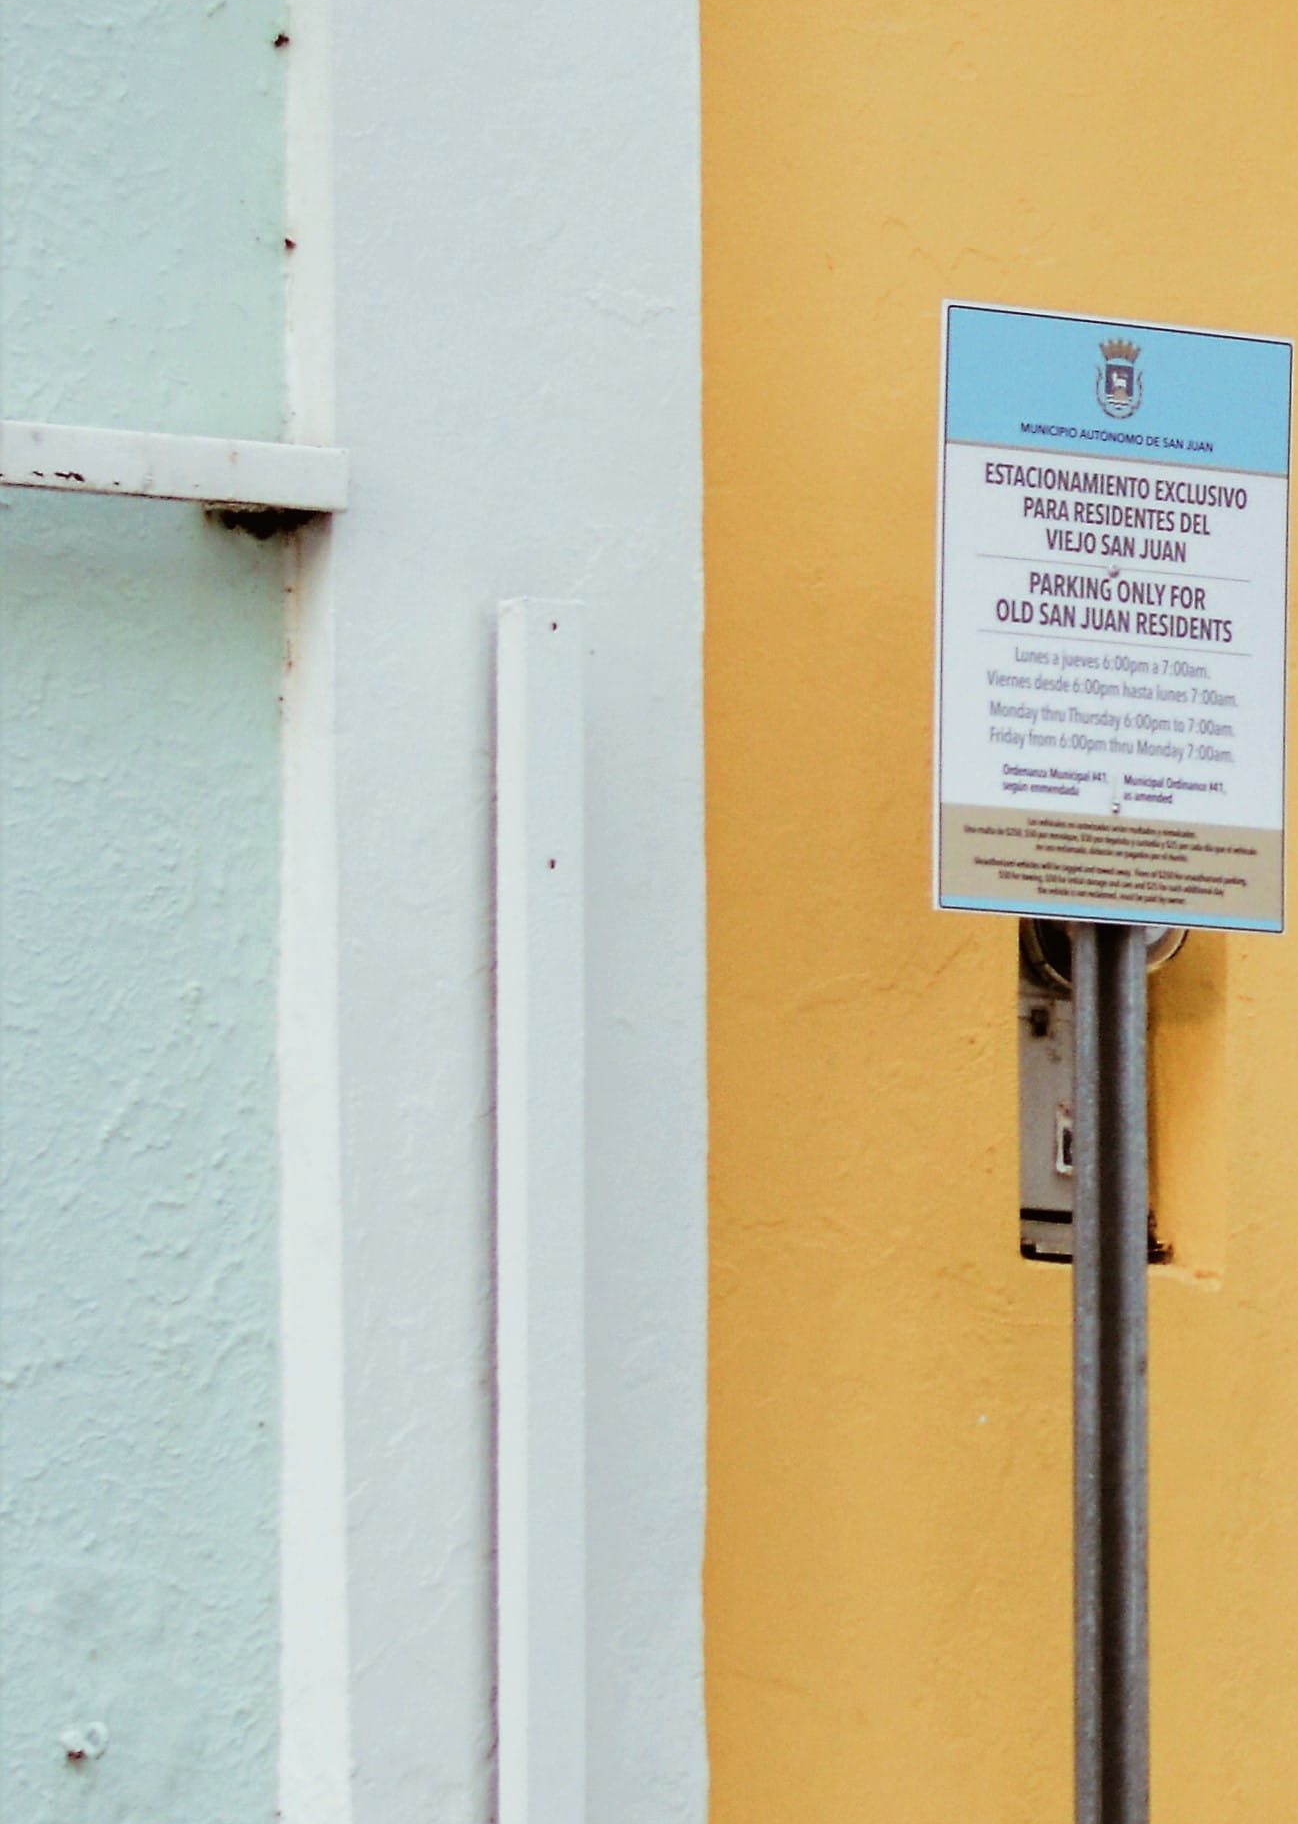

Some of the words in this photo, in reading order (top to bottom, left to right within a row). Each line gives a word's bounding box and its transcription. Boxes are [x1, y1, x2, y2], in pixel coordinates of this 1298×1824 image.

[1020, 422, 1077, 438] MUNICIPIO
[1145, 435, 1159, 446] DE
[1162, 437, 1183, 448] SAN
[1186, 440, 1212, 452] JUAN
[985, 462, 1149, 499] ESTACIONAMIENTO
[1155, 479, 1247, 509] EXCLUSIVO
[1023, 496, 1069, 521] PARA
[1074, 501, 1174, 531] RESIDENTES
[1180, 512, 1210, 535] DEL
[1046, 528, 1096, 553] VIEJO
[1100, 533, 1134, 557] SAN
[1139, 538, 1185, 562] JUAN
[1029, 571, 1112, 600] PARKING
[1117, 579, 1165, 606] ONLY
[1170, 585, 1205, 610] FOR
[996, 598, 1033, 623] OLD
[1039, 602, 1075, 627] SAN
[1079, 606, 1129, 632] JUAN
[1136, 611, 1232, 642] RESIDENTS
[1014, 646, 1050, 664] Lunes
[1051, 653, 1059, 665] a
[1061, 650, 1100, 670] jueves
[1101, 654, 1149, 676] 6:00pm
[1151, 661, 1159, 674] a
[986, 669, 1032, 688] Viernes
[1033, 673, 1071, 692] desde
[1071, 677, 1119, 699] 6:00pm
[1122, 681, 1153, 700] hasta
[1155, 684, 1188, 703] lunes
[989, 699, 1038, 723] Monday
[1040, 705, 1065, 722] thru
[1067, 706, 1121, 731] Thursday
[1122, 712, 1171, 734] 6:00pm
[1172, 717, 1185, 732] to
[989, 725, 1025, 749] Friday
[1028, 728, 1056, 746] from
[1058, 732, 1106, 754] 6:00pm
[1108, 736, 1133, 754] thru
[1136, 739, 1184, 762] Monday
[1048, 768, 1090, 782] Municipal
[1123, 774, 1164, 789] Municipal
